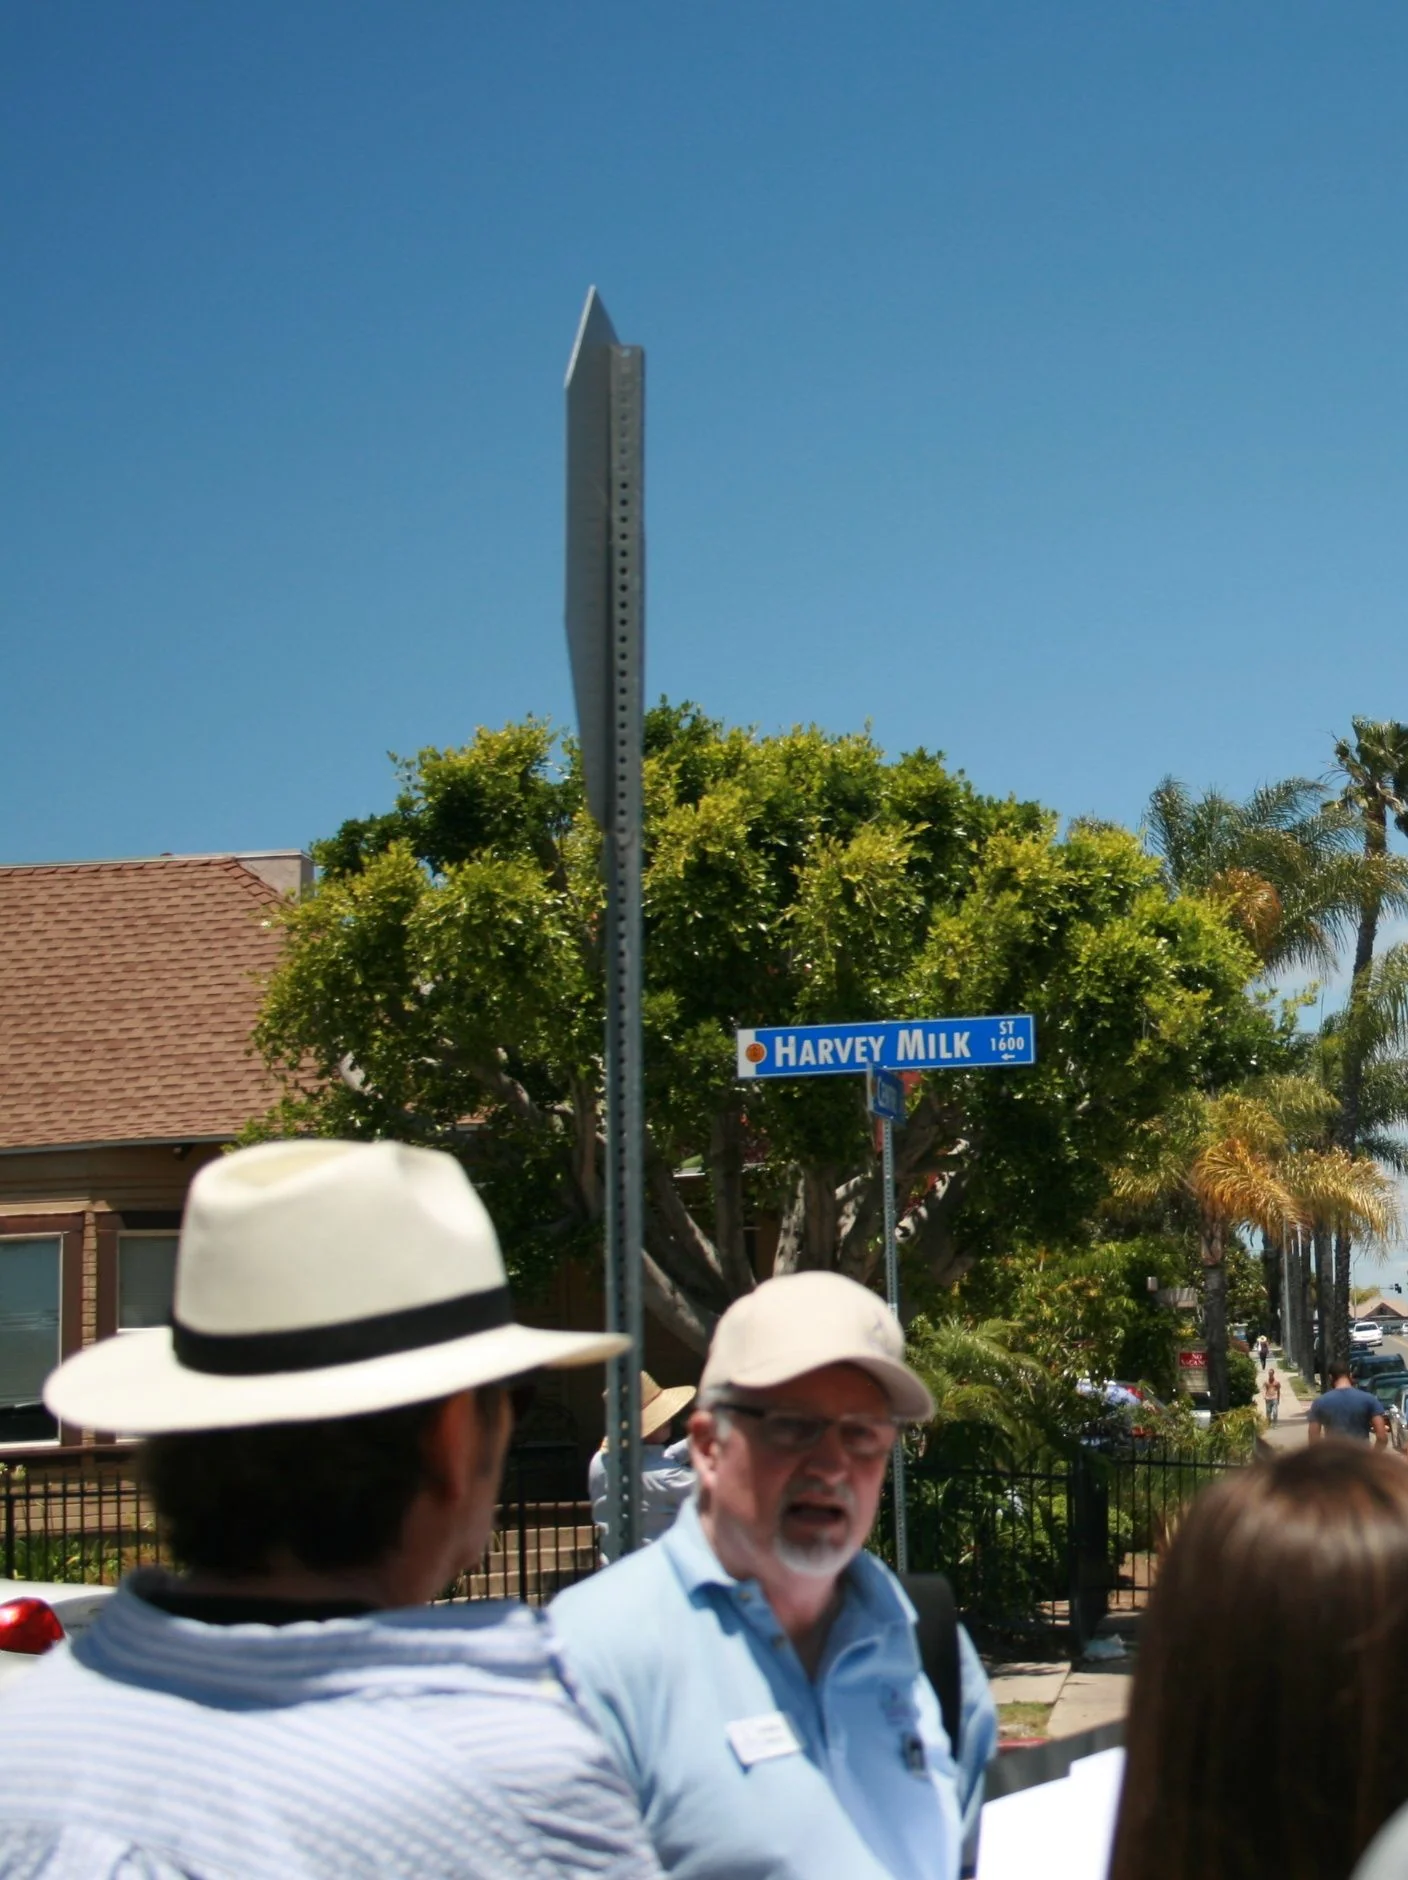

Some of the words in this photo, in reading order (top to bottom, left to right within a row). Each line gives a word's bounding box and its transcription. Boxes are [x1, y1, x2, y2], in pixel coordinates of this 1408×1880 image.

[999, 1020, 1014, 1035] ST
[775, 1035, 885, 1067] HARVEY
[896, 1029, 972, 1061] MILK
[990, 1036, 1025, 1052] 1600
